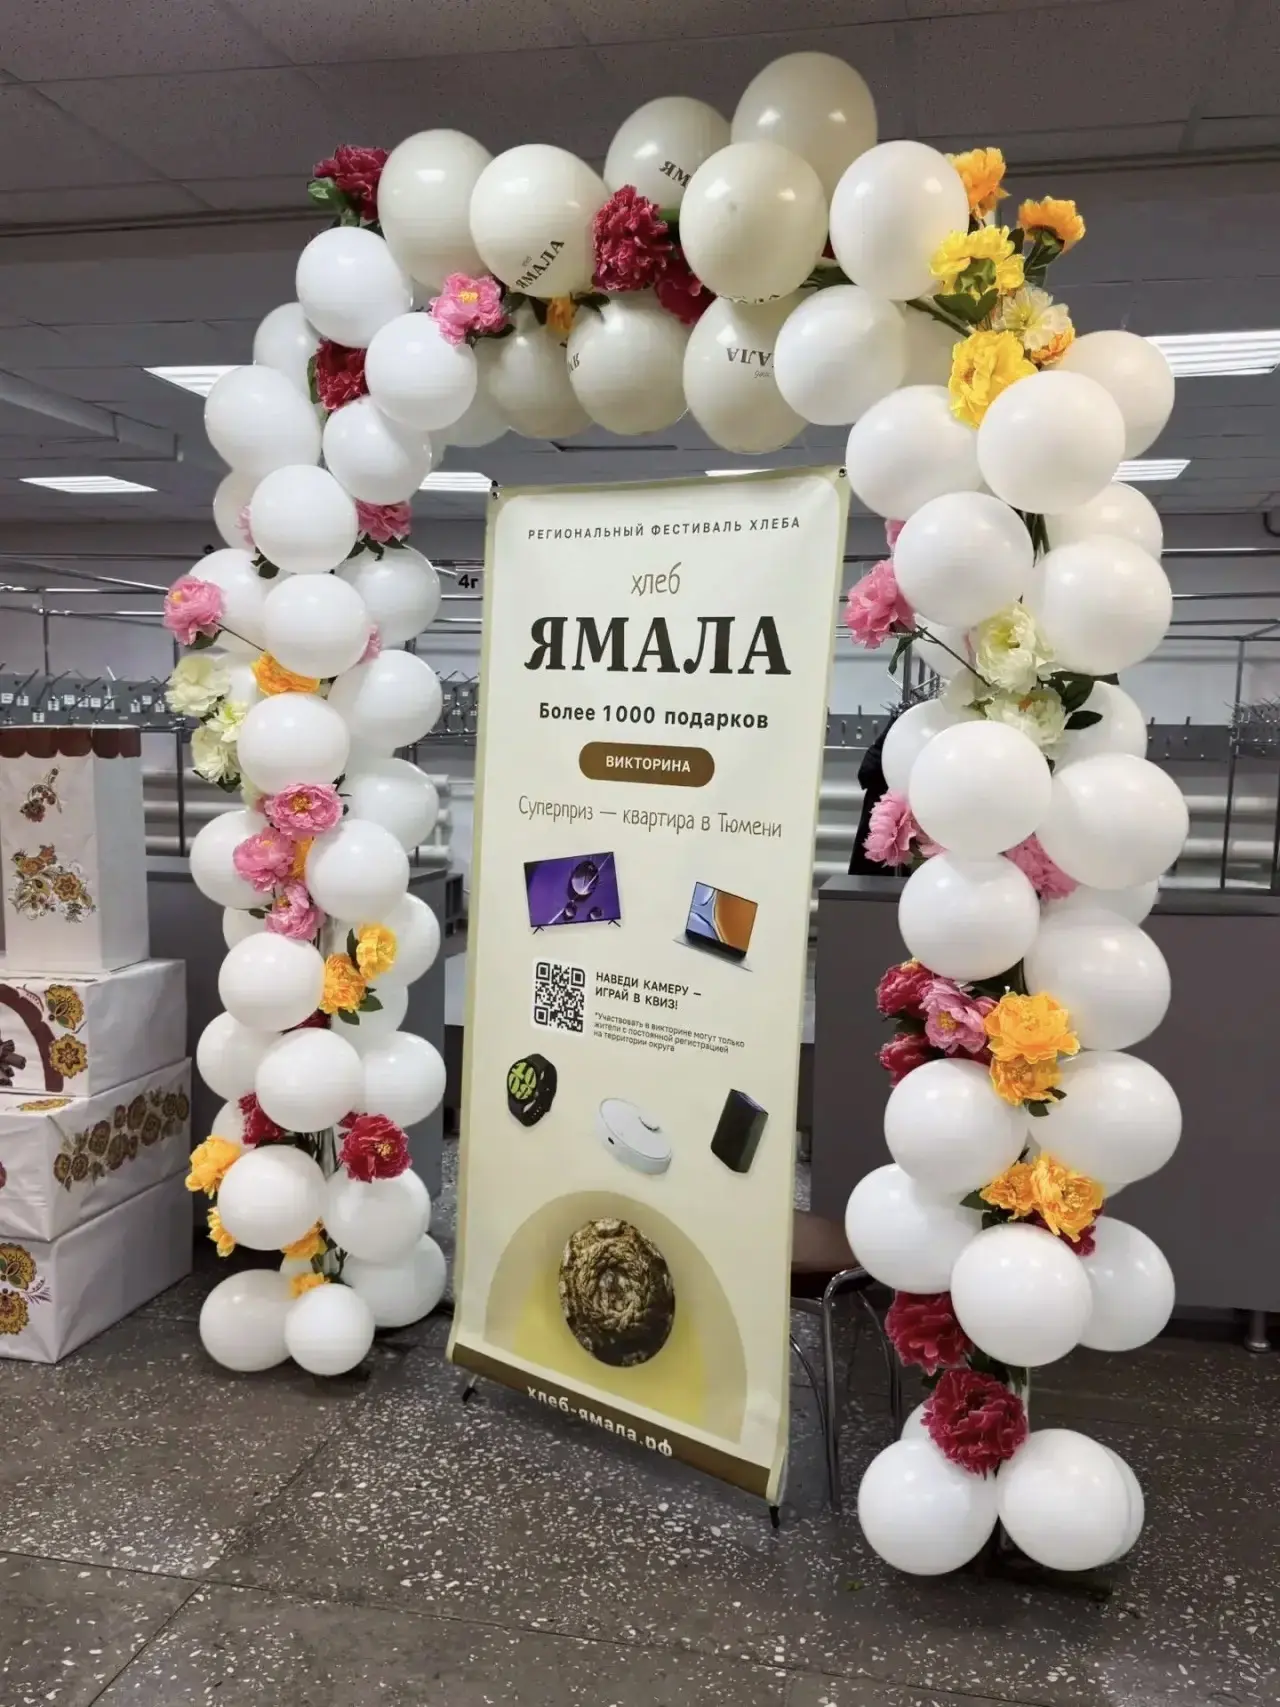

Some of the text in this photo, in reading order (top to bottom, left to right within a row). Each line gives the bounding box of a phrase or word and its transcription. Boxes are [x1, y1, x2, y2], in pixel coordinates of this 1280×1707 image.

[515, 240, 565, 289] ЯМАЛА
[528, 516, 800, 540] РЕГИОНАЛЬНЫЙ ФЕСТИВАЛЬ ХЛЕБА
[631, 561, 682, 596] хлеб
[524, 615, 792, 675] ЯМАЛА
[539, 702, 769, 731] Более 1000 подарков
[605, 755, 691, 773] ВИКТОРИНА
[518, 795, 594, 824] Суперприз
[622, 807, 695, 835] квартира
[701, 815, 711, 831] в
[718, 812, 782, 838] Тюмени
[595, 986, 678, 1010] ИГРАЙ В КВИЗ!
[596, 971, 639, 988] НАВЕДИ
[643, 979, 689, 996] КАМЕРУ
[593, 1029, 675, 1053] на территории округа
[594, 1022, 621, 1032] жители
[628, 1028, 673, 1043] постоянной
[674, 1036, 729, 1054] регистрацией
[651, 1023, 692, 1037] викторине
[693, 1030, 717, 1043] могут
[718, 1035, 745, 1048] только
[527, 1384, 673, 1458] хлеб-ямала.рф
